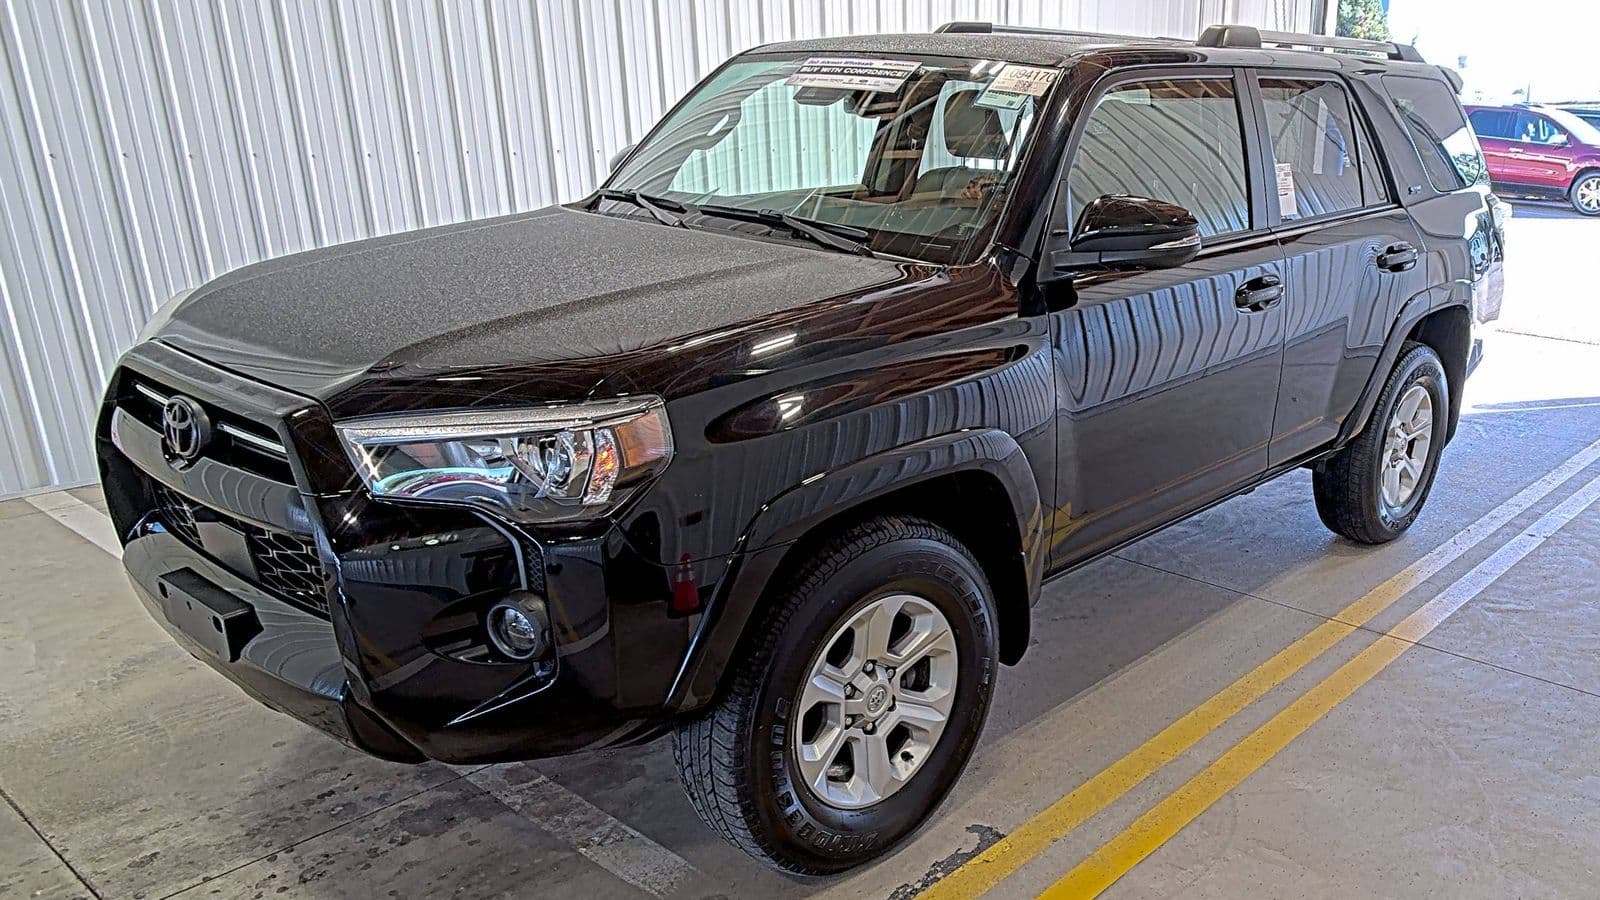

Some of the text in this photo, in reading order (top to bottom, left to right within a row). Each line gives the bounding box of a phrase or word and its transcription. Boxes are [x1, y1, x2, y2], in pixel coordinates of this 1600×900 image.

[800, 65, 909, 78] BUY WITH CONFIDENCE!
